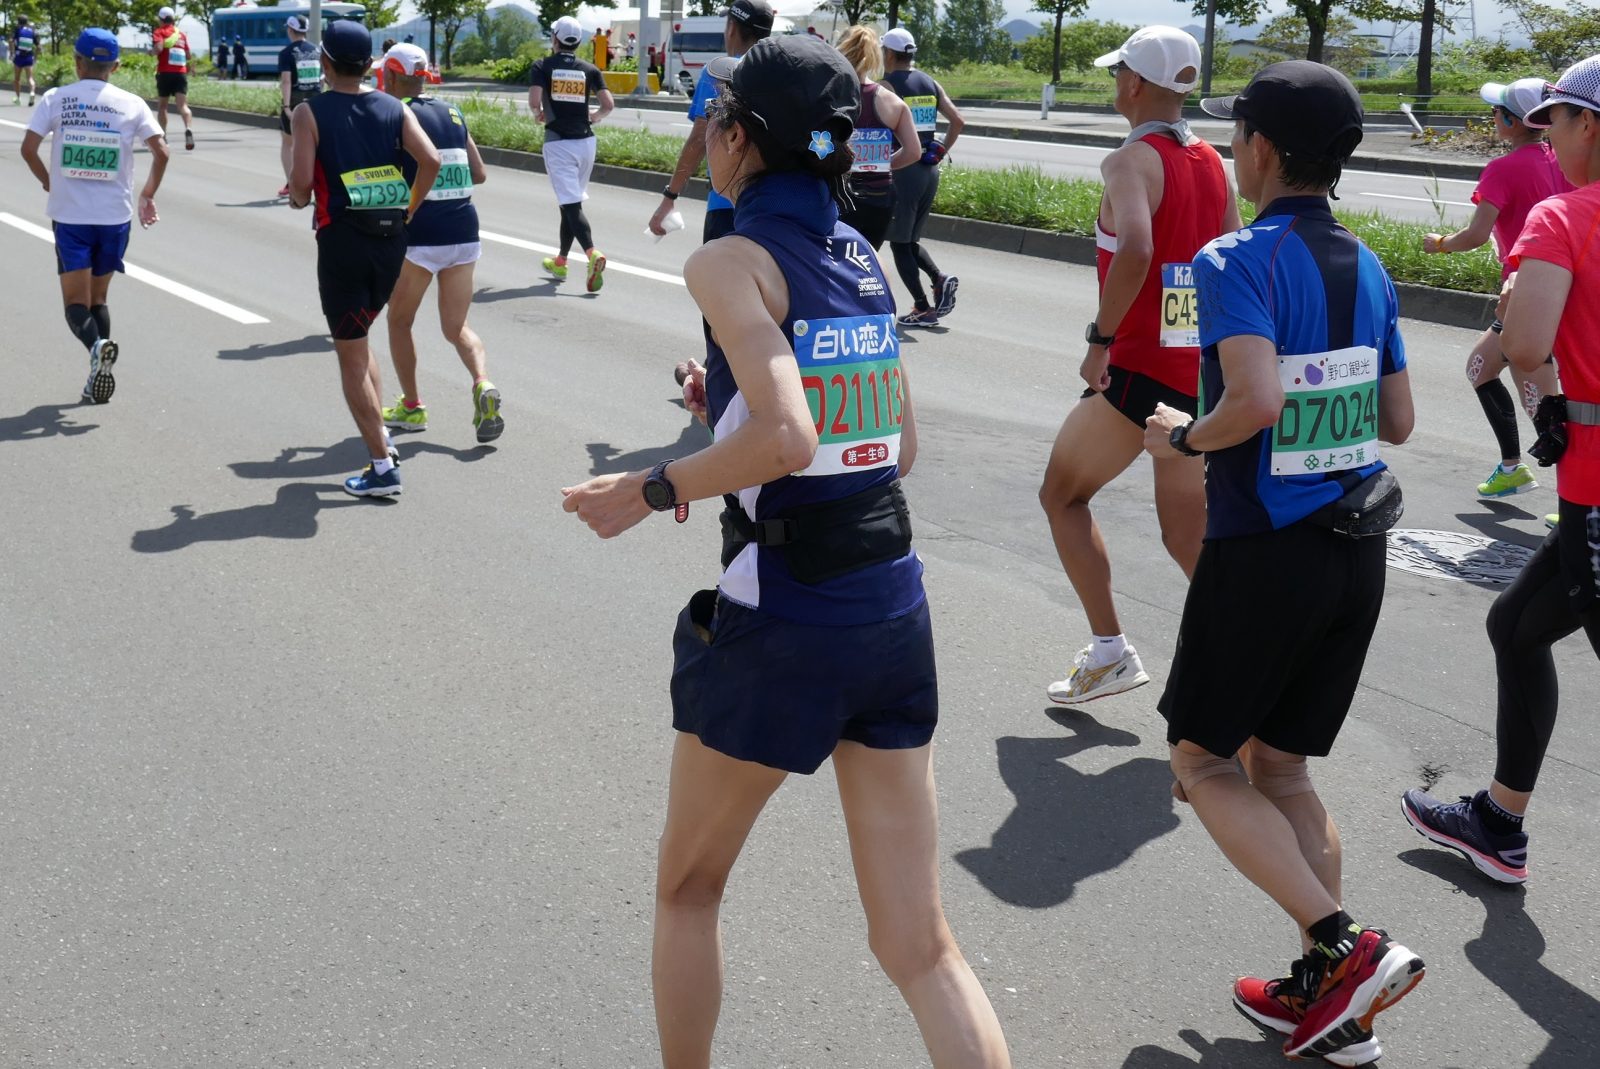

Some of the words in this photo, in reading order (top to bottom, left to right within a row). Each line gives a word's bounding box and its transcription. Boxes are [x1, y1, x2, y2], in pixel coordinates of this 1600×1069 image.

[552, 80, 585, 96] E7832
[61, 111, 87, 119] ULTRA
[62, 103, 99, 112] SAROMA
[61, 119, 110, 128] MARATHON
[65, 134, 86, 142] DNP
[62, 146, 117, 169] D4642
[850, 144, 890, 162] 22118
[364, 168, 396, 179] SVOLME
[349, 182, 409, 206] D7392
[812, 322, 895, 360] 白い恋人
[1327, 358, 1370, 381] 野口観光
[801, 367, 904, 437] D21113
[1277, 387, 1376, 446] D7024
[847, 446, 886, 464] 第一生命
[1323, 448, 1365, 468] よつ葉
